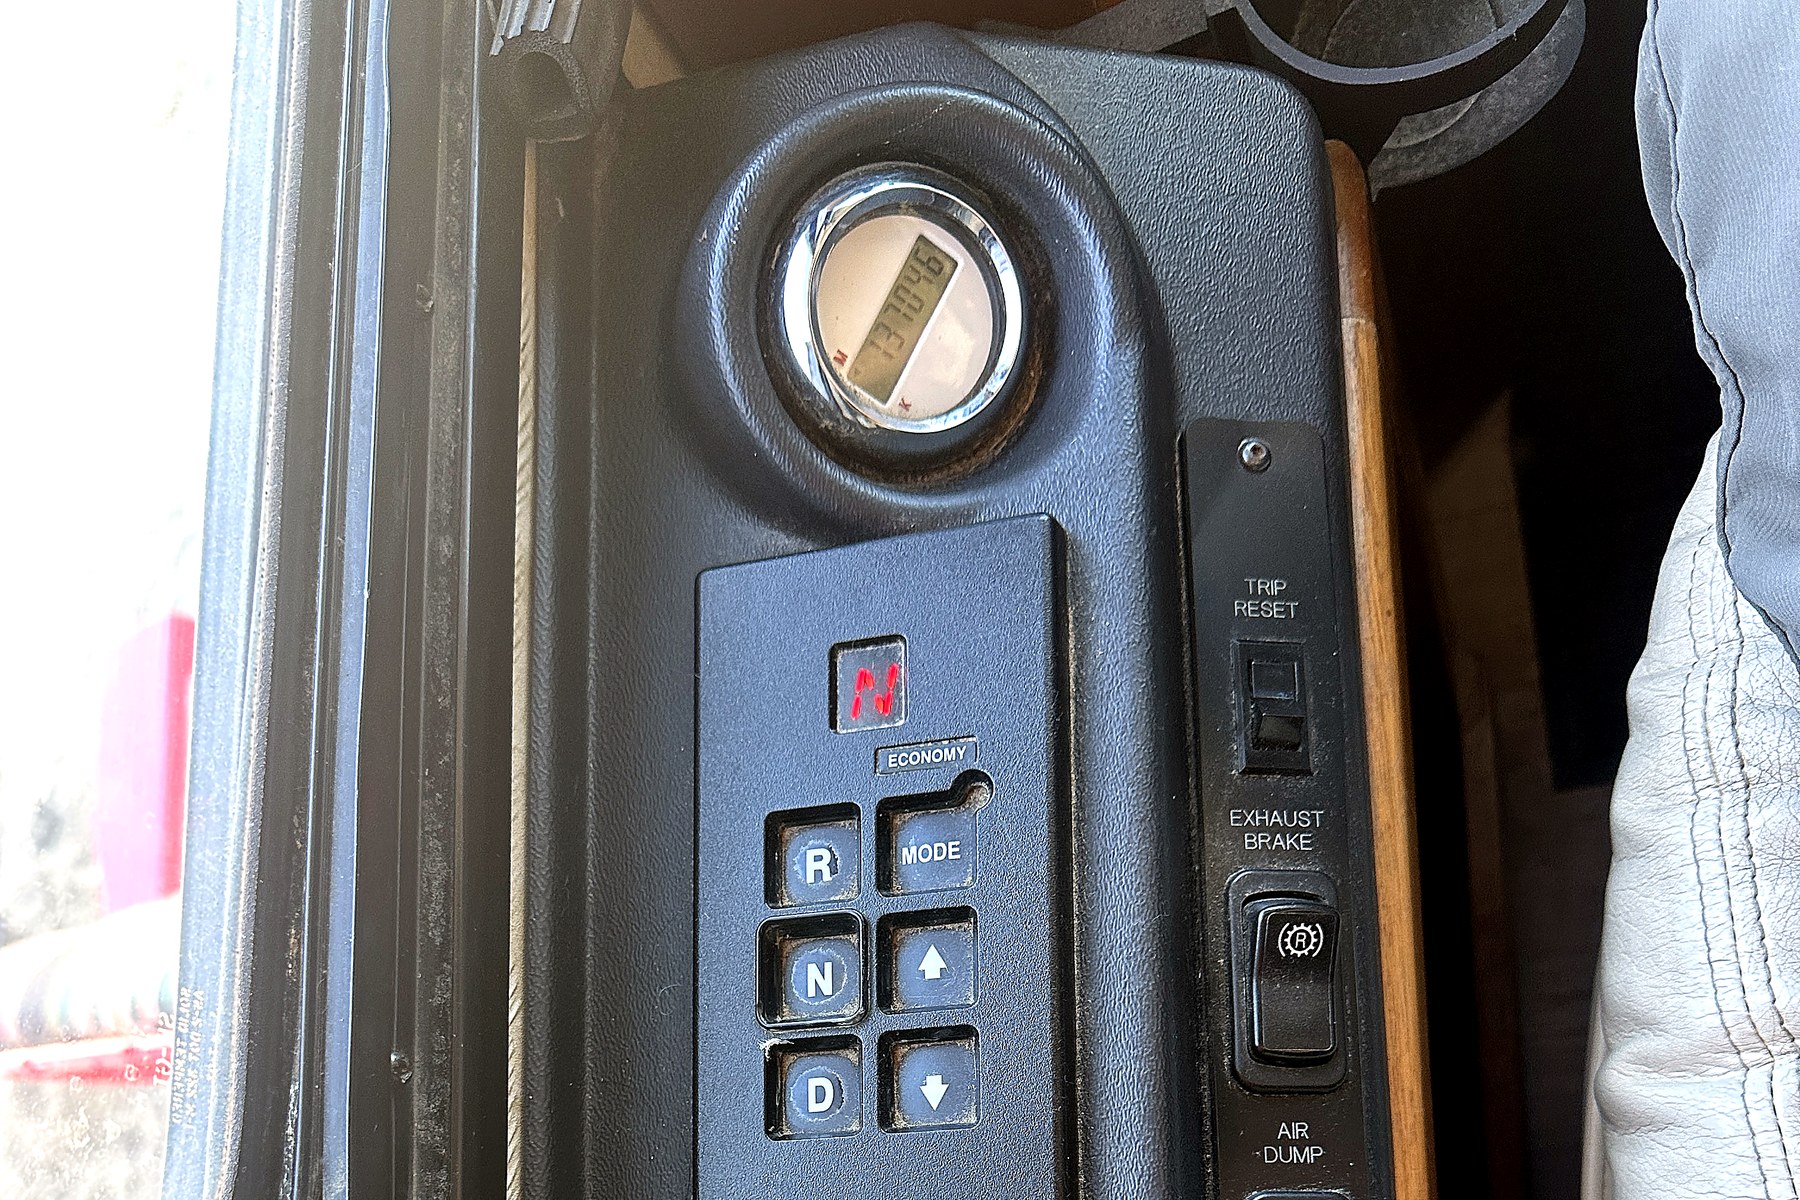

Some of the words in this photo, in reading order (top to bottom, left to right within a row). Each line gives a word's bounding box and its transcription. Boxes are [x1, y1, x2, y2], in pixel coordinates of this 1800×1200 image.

[868, 246, 945, 360] 137046
[1244, 578, 1287, 596] TRIP
[1234, 601, 1298, 619] RESET
[851, 663, 899, 720] N
[888, 746, 966, 768] ECONOMY
[1229, 810, 1324, 828] EXHAUST
[1244, 833, 1313, 851] BRAKE
[902, 841, 961, 866] MODE
[805, 848, 833, 884] R
[807, 962, 833, 997] N
[807, 1077, 834, 1112] D
[1278, 1122, 1309, 1140] AIR
[1264, 1146, 1323, 1164] DUMP
